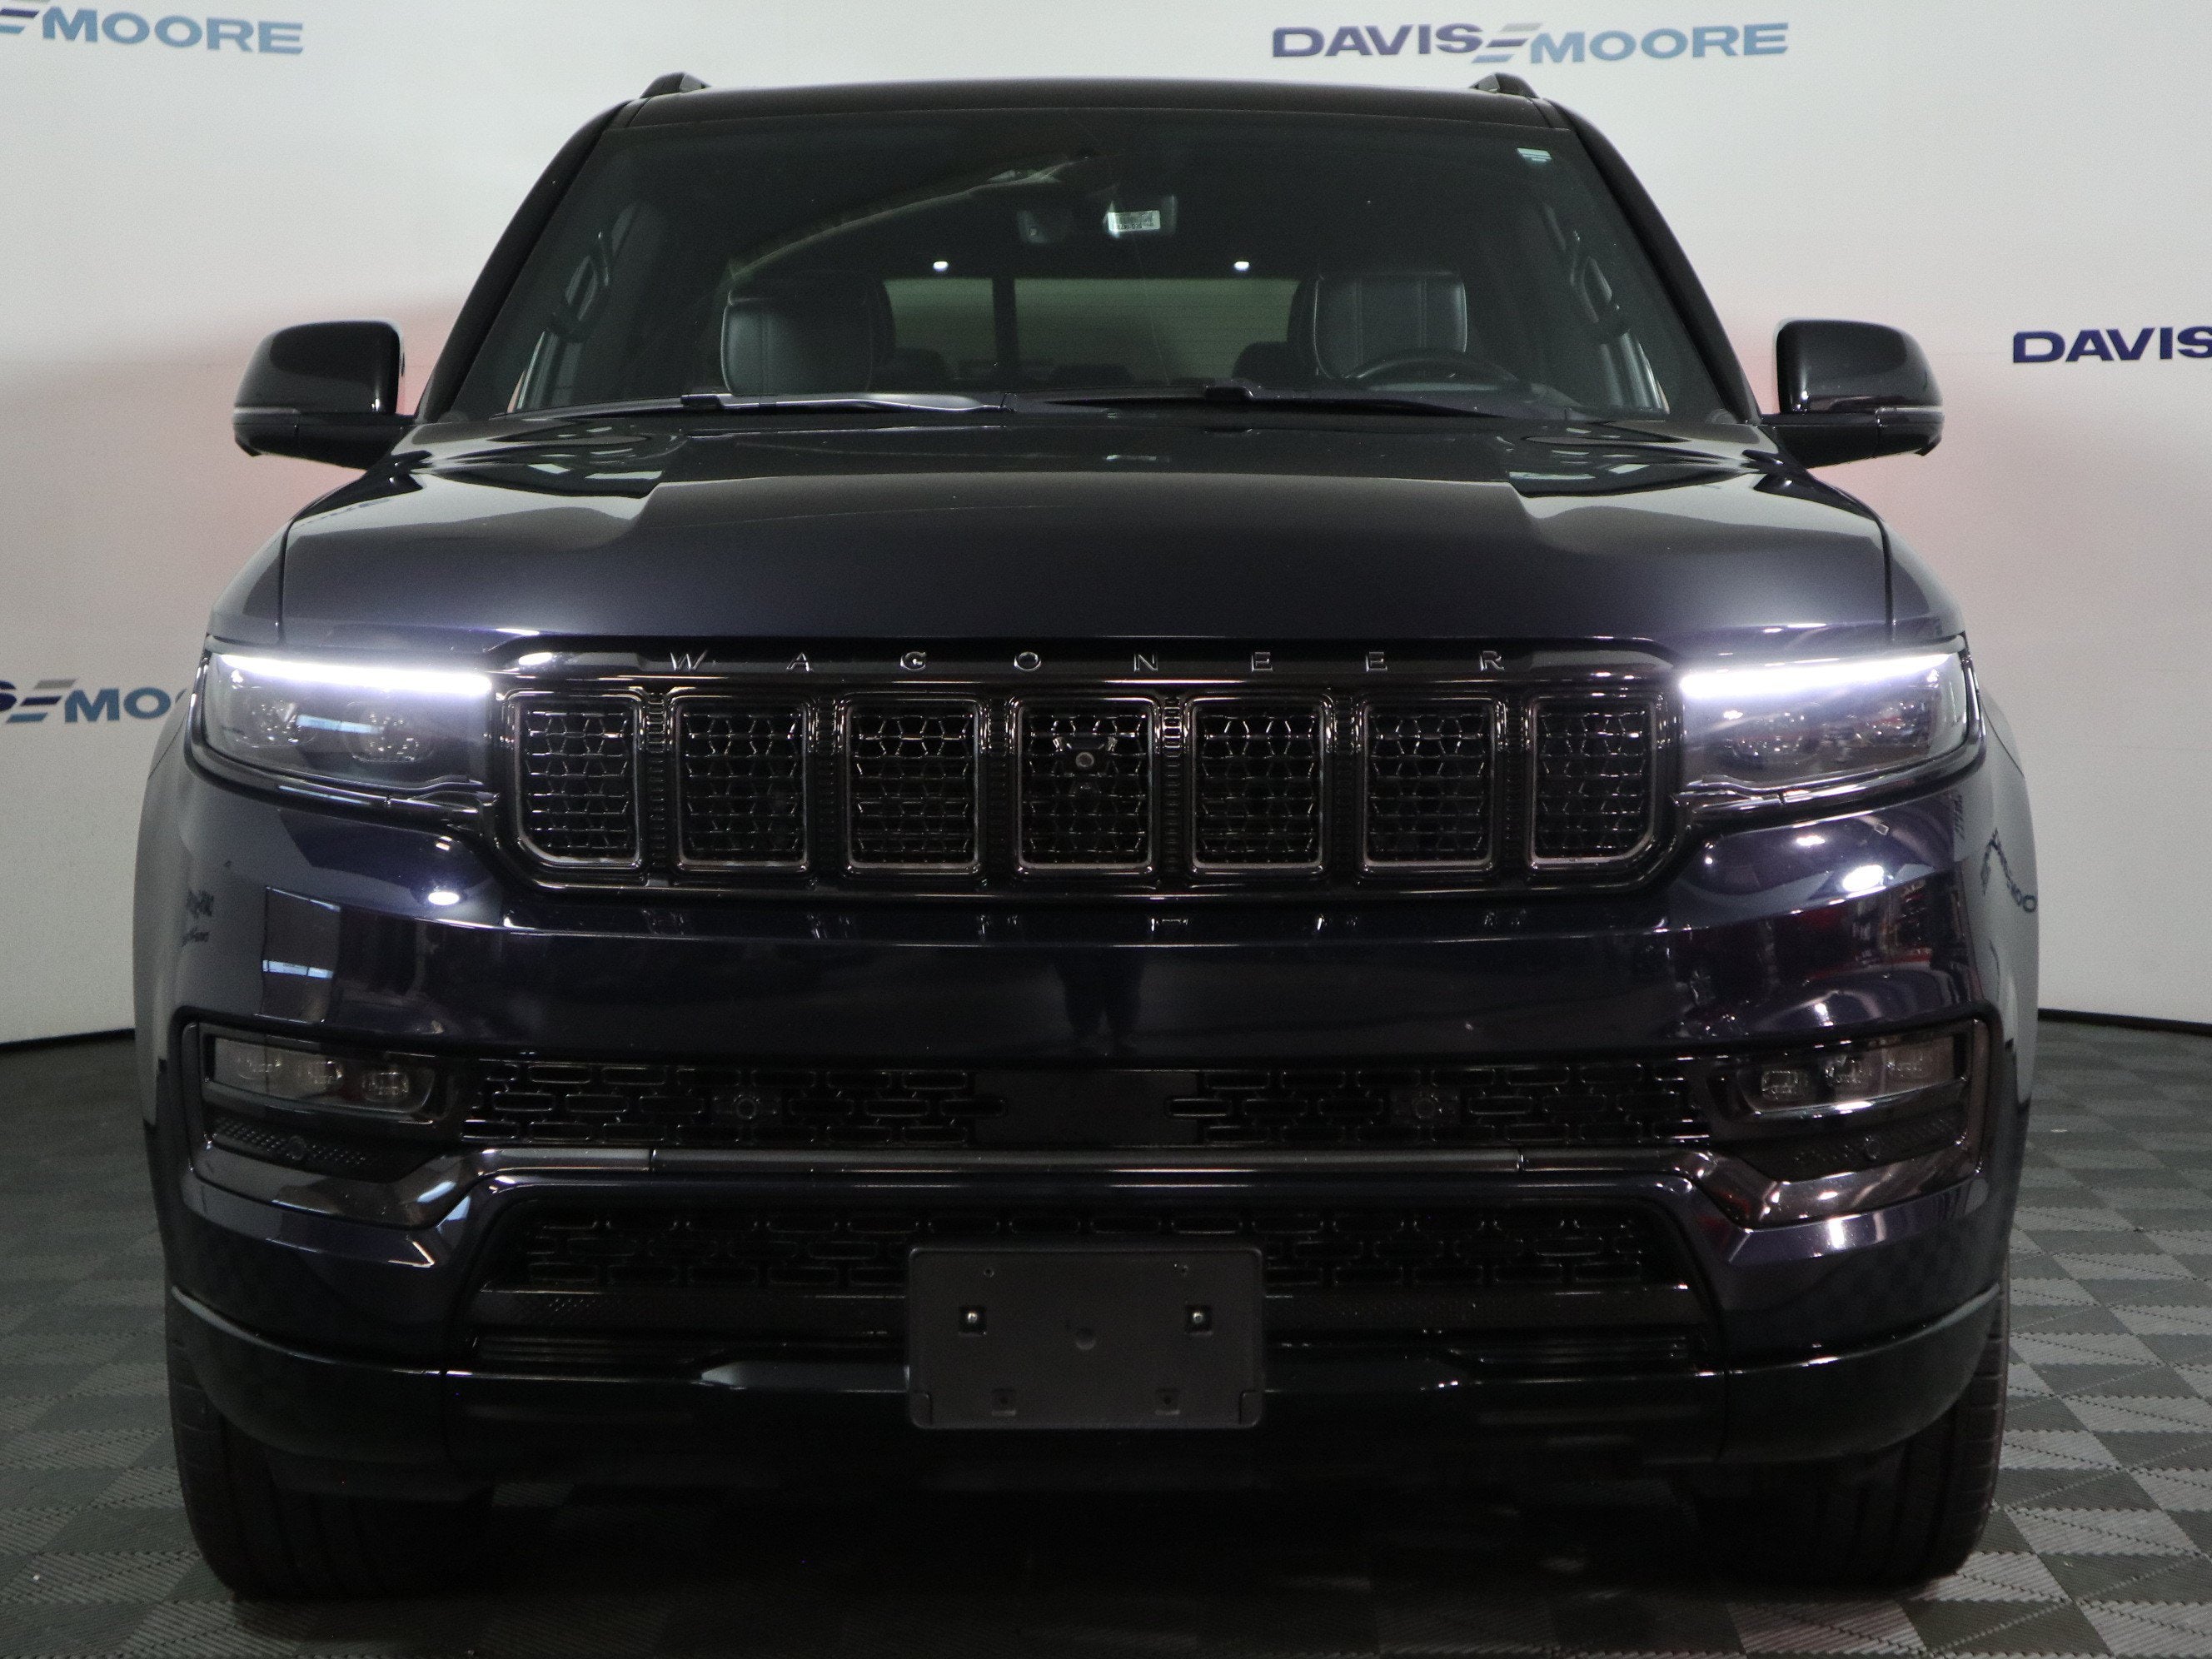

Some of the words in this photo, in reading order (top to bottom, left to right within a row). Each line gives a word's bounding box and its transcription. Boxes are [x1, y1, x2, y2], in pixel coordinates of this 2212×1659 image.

[42, 6, 304, 54] MOORE
[1272, 22, 1485, 58] DAVIS
[1528, 22, 1790, 64] MOORE
[2013, 326, 2212, 363] DAVIS
[669, 649, 1506, 672] WAGONEER
[64, 686, 187, 723] MO
